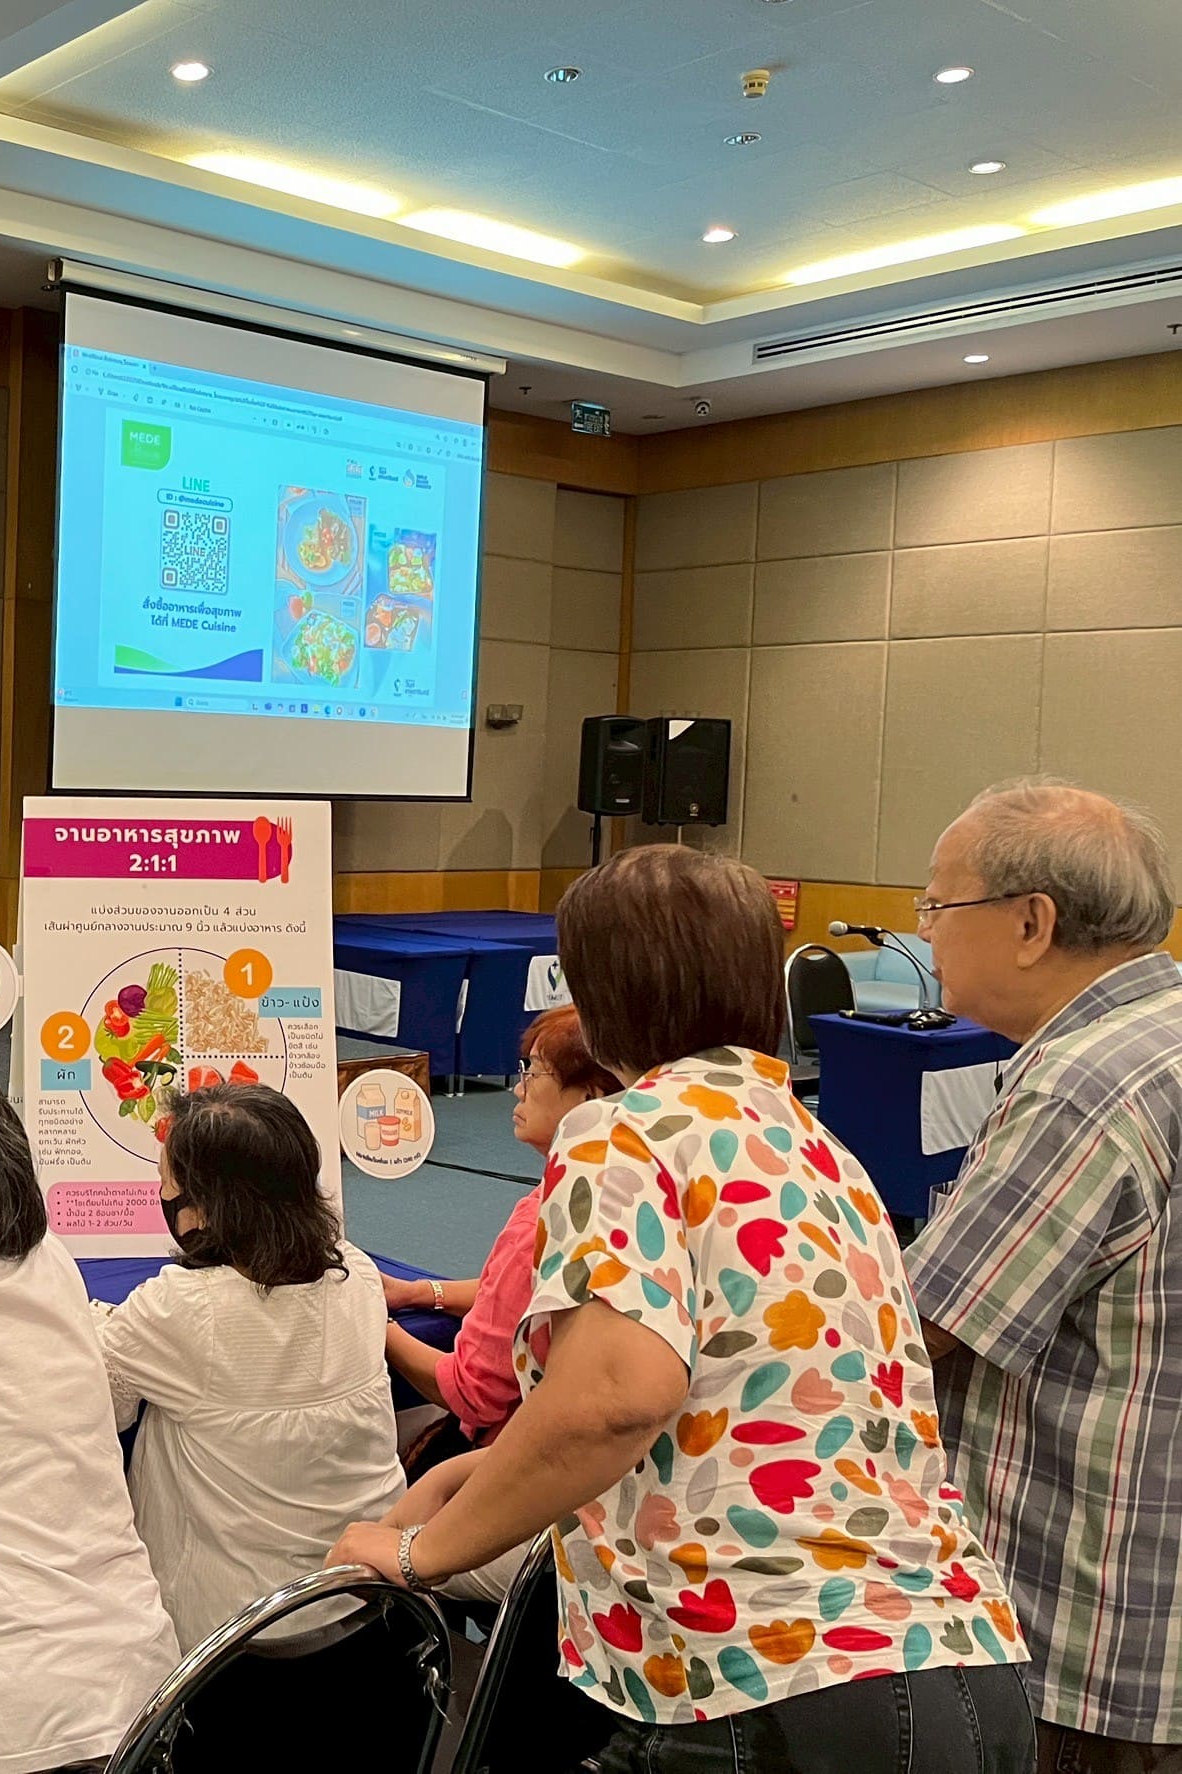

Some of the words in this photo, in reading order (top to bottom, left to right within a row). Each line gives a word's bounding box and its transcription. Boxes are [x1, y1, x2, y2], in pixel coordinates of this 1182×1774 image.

[130, 432, 161, 445] MEDE
[182, 477, 210, 492] LINE
[184, 546, 206, 557] LINE
[172, 617, 198, 629] MEDE
[201, 620, 237, 632] Cuisine
[54, 827, 241, 849] จานอาหารสุขภาพ
[129, 854, 177, 872] 2:1:1
[91, 904, 218, 916] แบ่งส่วนของจานออกเป็น
[223, 907, 230, 916] 4
[235, 905, 256, 916] ส่วน
[186, 922, 192, 932] 9
[196, 921, 210, 933] นิ้ว
[213, 921, 282, 933] แล้วแบ่งอาหาร
[285, 920, 306, 934] ดังนี้
[241, 962, 253, 986] 1
[57, 1025, 75, 1049] 2
[56, 1068, 76, 1080] ผัก
